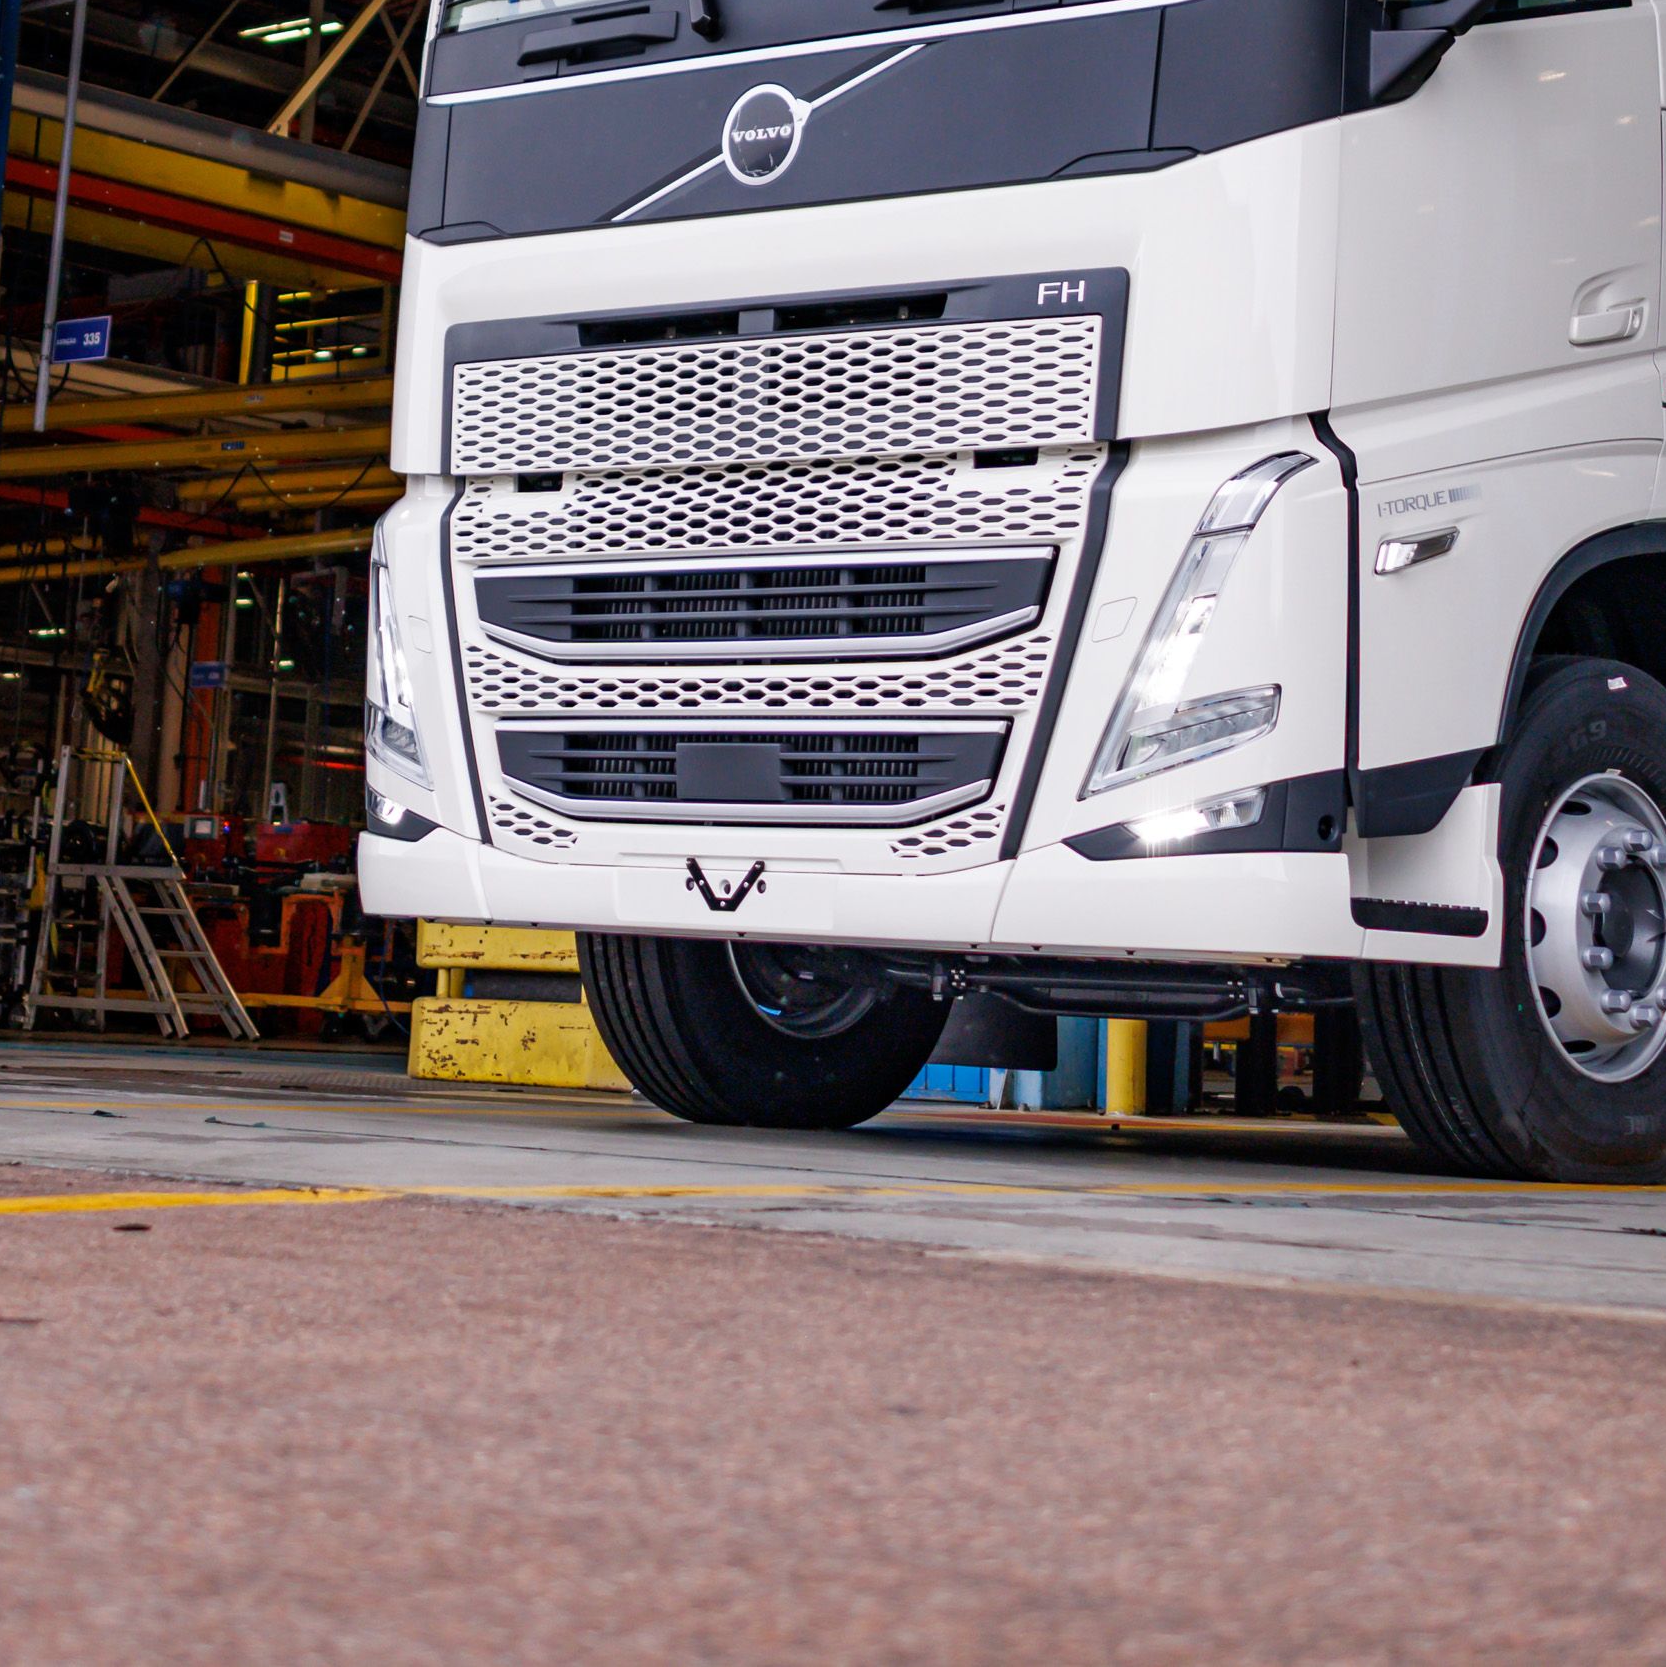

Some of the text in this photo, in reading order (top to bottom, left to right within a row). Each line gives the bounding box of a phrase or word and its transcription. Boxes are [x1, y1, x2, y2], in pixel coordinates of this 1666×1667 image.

[731, 125, 792, 143] VOLVO
[1037, 280, 1085, 305] FH
[1377, 490, 1448, 517] I-TORQUE
